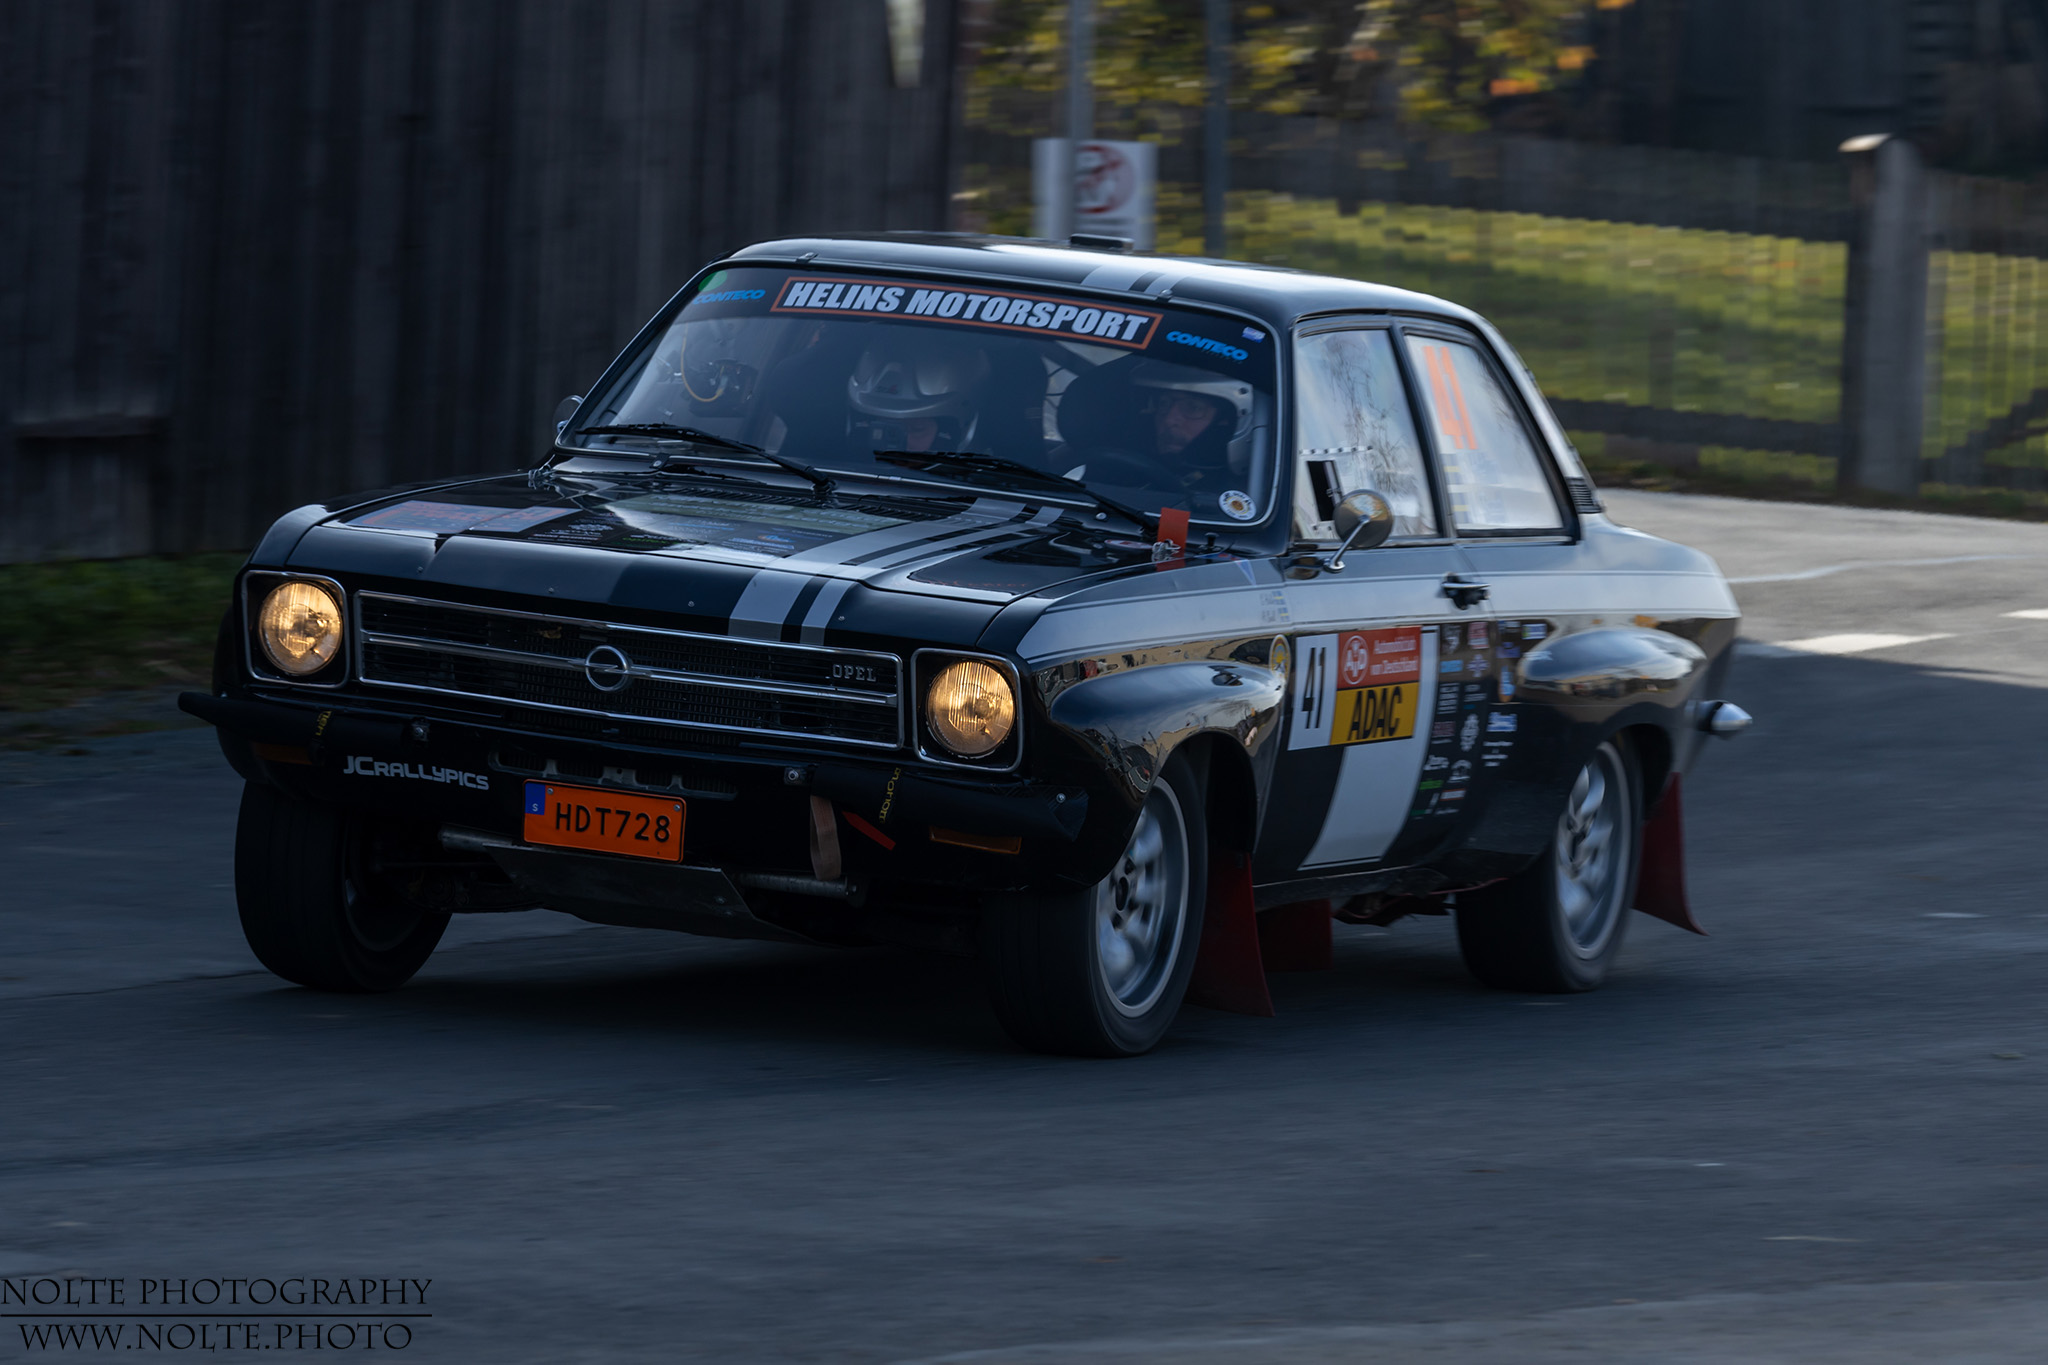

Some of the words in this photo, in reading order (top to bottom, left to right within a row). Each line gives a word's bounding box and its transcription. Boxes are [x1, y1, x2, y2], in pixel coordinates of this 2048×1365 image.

[693, 288, 766, 305] CONTECO
[783, 281, 904, 313] HELINS
[904, 287, 1150, 341] MOTORSPORT
[1165, 330, 1249, 361] CONTECO
[832, 663, 877, 683] OPEL
[1302, 647, 1326, 729] 41
[1346, 686, 1402, 741] ADAC
[556, 802, 672, 843] HDT728
